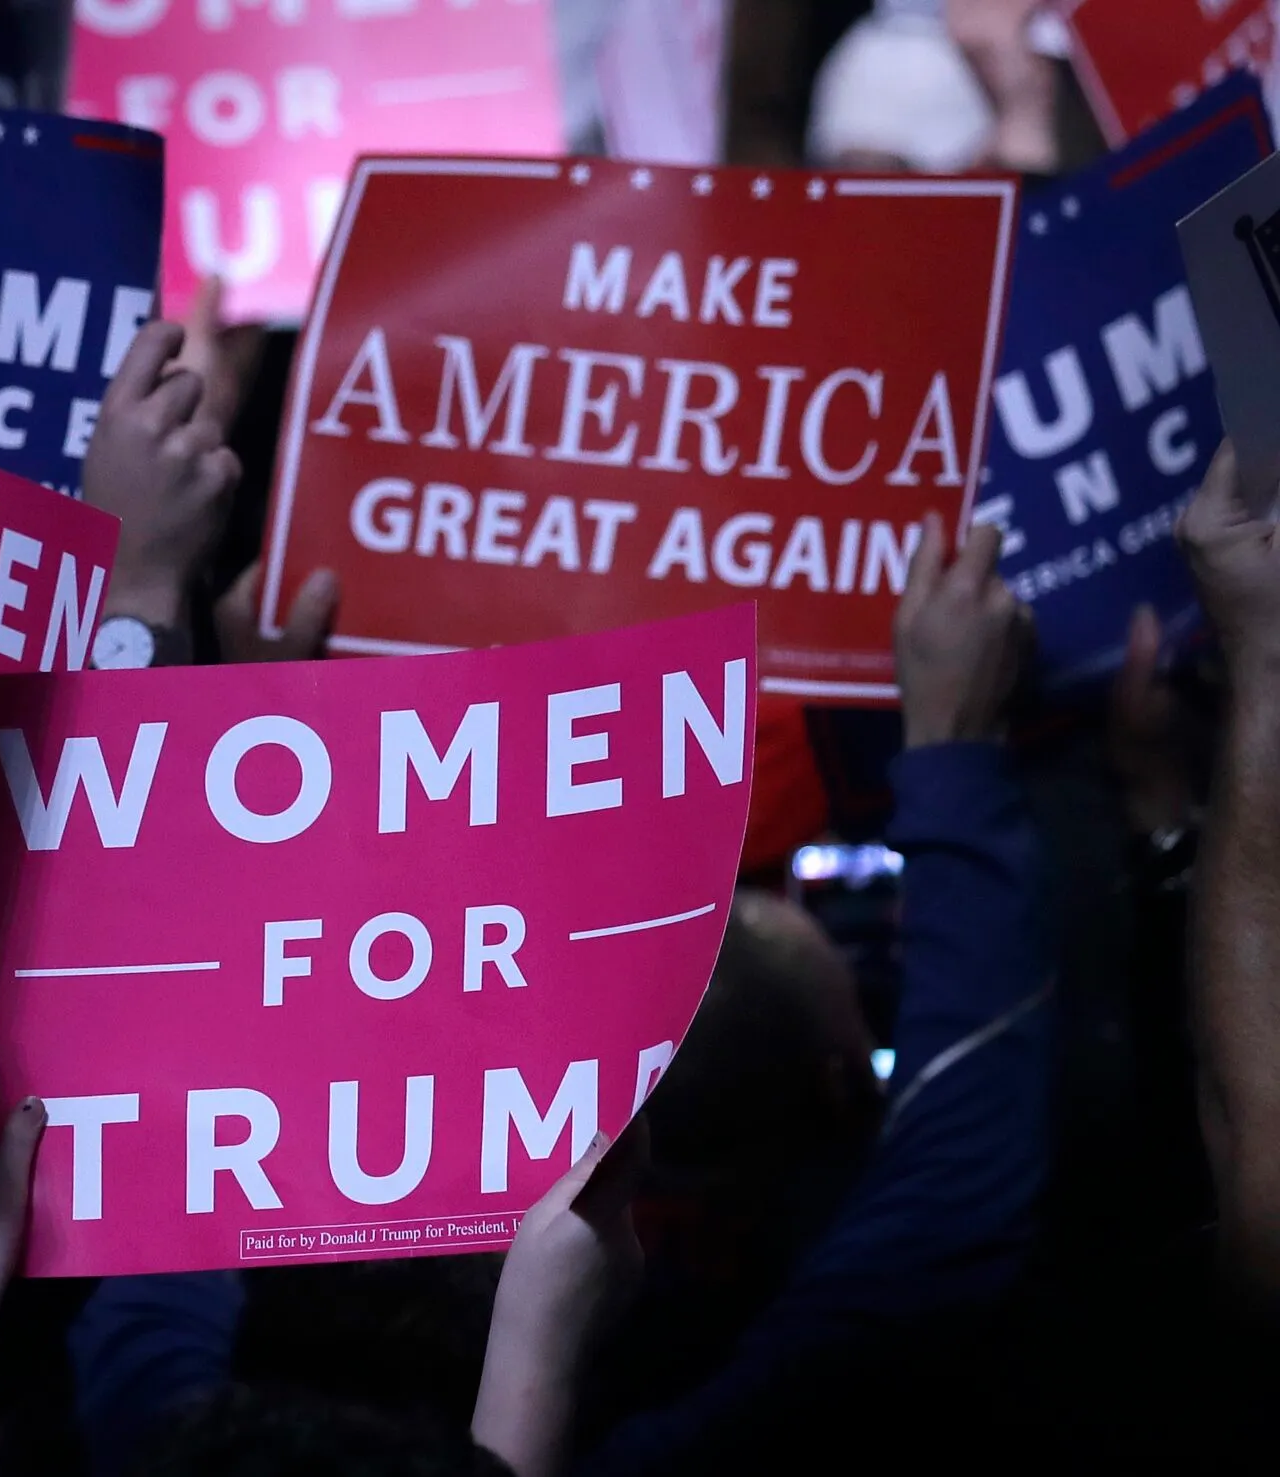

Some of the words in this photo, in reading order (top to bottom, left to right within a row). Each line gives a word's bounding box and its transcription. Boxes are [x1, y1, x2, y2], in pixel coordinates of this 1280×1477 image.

[116, 63, 343, 147] FOR
[563, 242, 798, 327] MAKE
[311, 326, 965, 487] AMERICA
[351, 477, 636, 573] GREAT
[263, 905, 527, 1006] FOR
[246, 1234, 274, 1250] Paid
[278, 1234, 296, 1248] for
[300, 1232, 315, 1249] by
[320, 1228, 366, 1246] Donald
[370, 1228, 376, 1243] J
[380, 1227, 421, 1243] Trump
[425, 1223, 444, 1238] for
[447, 1219, 509, 1237] President,
